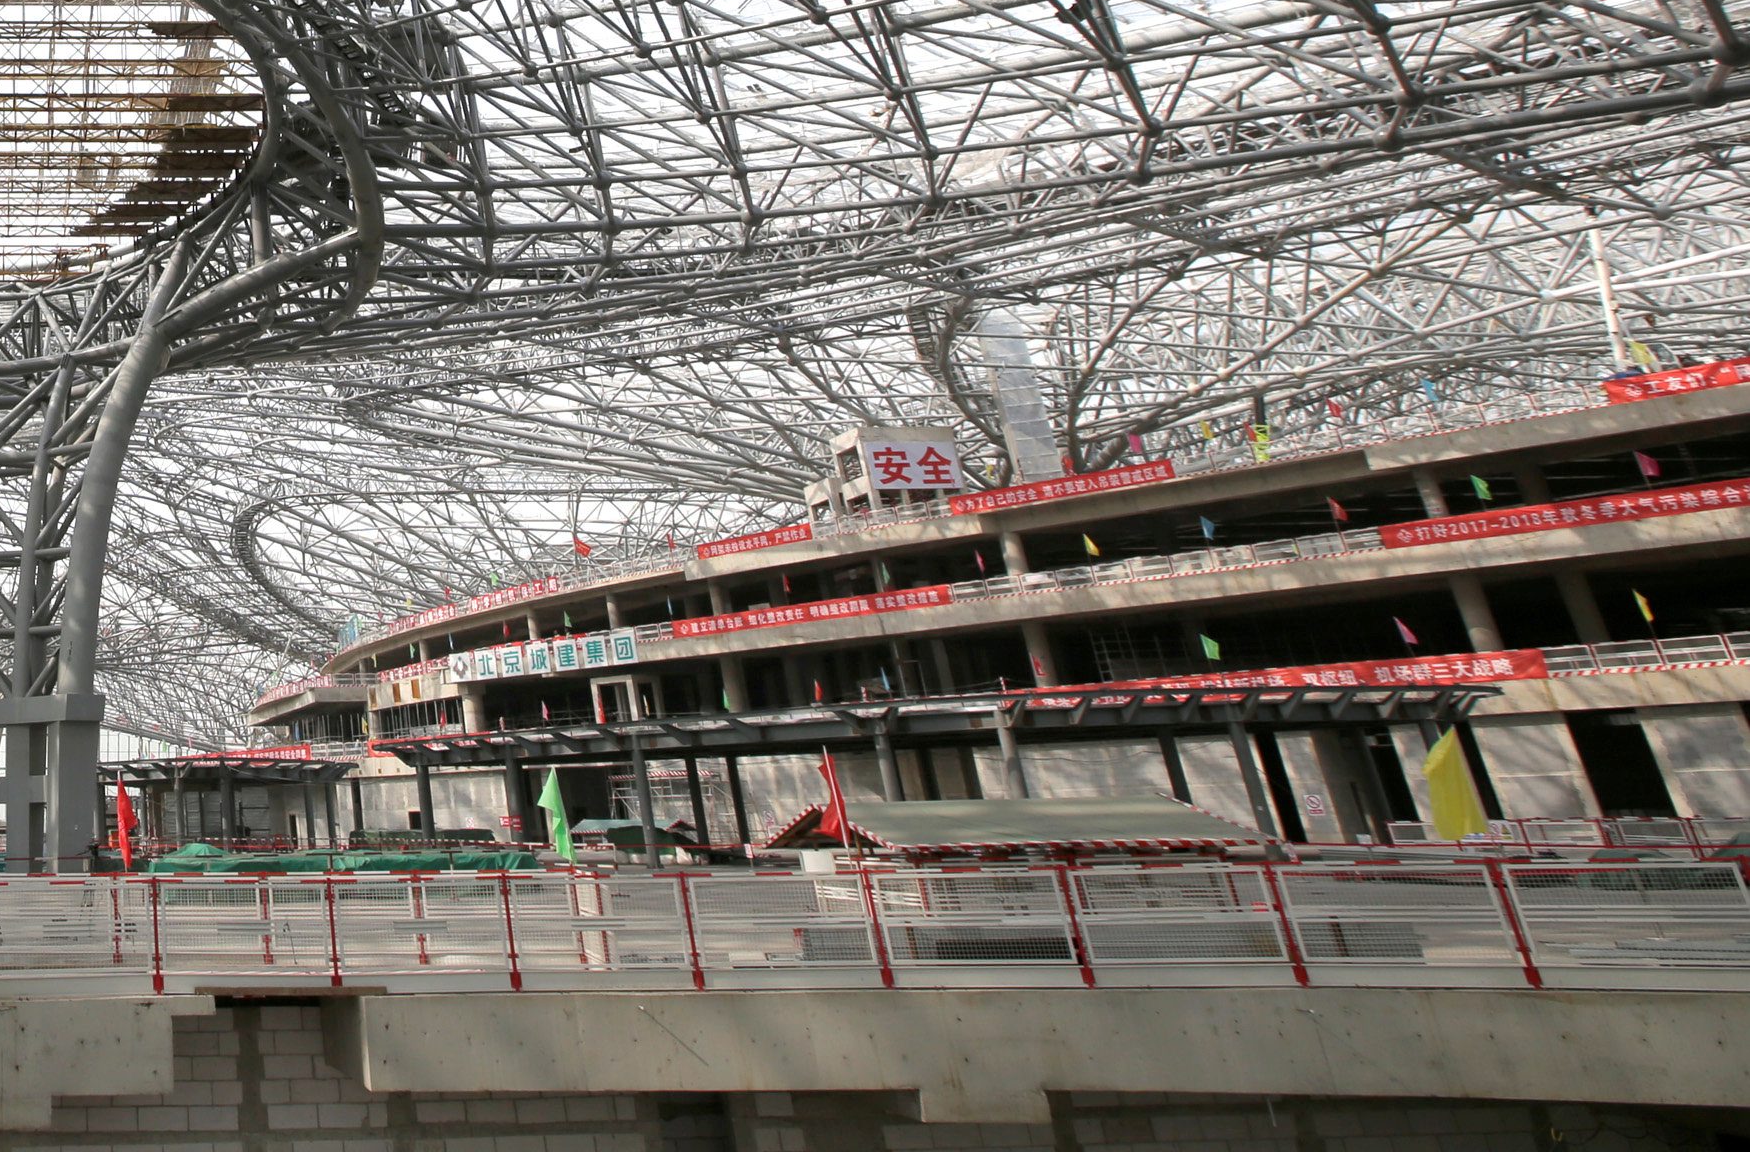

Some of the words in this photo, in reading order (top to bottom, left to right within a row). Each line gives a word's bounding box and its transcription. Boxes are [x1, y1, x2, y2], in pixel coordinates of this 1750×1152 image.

[873, 447, 955, 484] 安全
[964, 488, 1038, 511] 为了自己的安全
[1042, 463, 1168, 497] 请不要进入吊装警戒区域
[1415, 483, 1750, 540] 打好2017-2018年秋冬季大气污染综合
[690, 616, 743, 634] 建立清单台账
[747, 608, 803, 627] 细化整改责任
[808, 598, 870, 618] 明确整改期限
[875, 589, 939, 609] 落实整改措施
[478, 636, 633, 676] 北京城建集团
